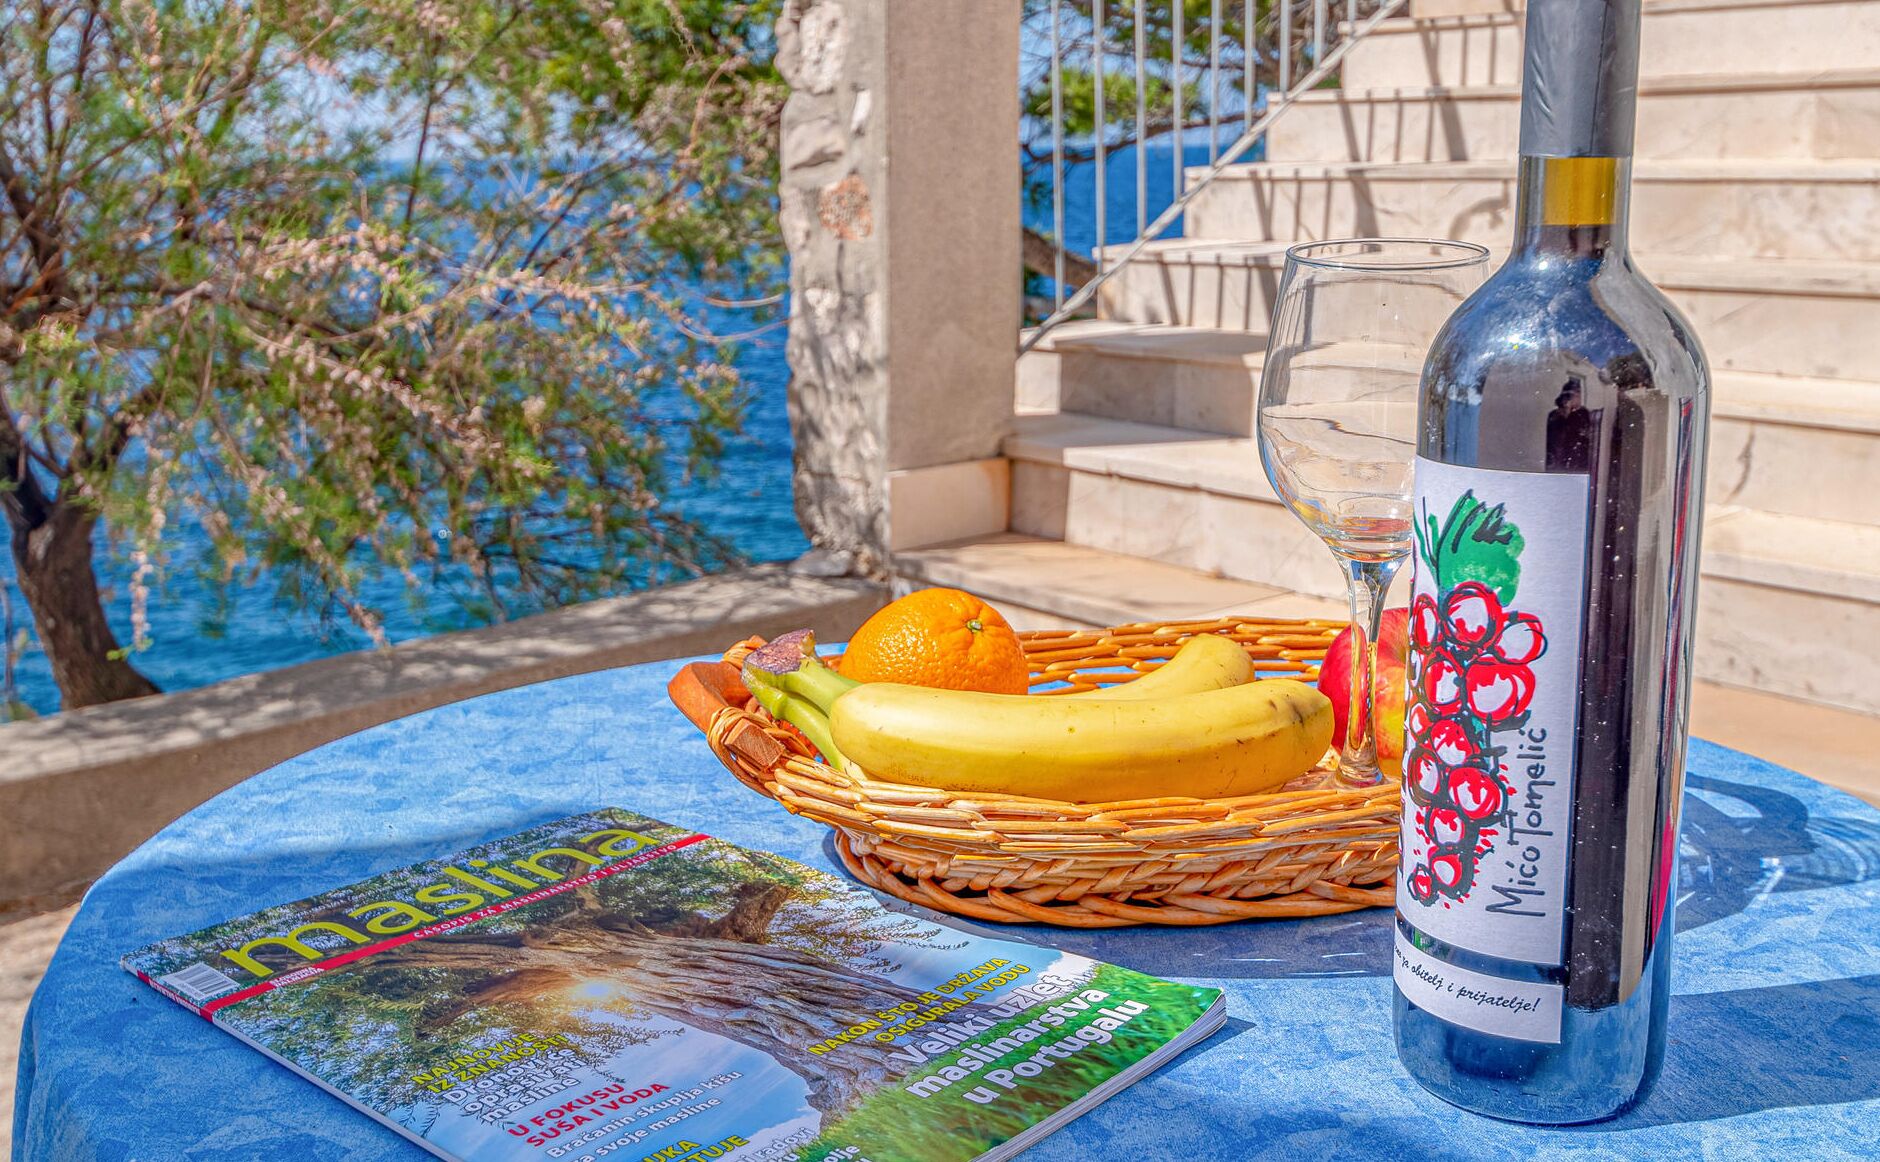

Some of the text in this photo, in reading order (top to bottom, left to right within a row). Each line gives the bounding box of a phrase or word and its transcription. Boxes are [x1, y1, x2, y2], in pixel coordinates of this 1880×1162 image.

[220, 829, 660, 977] maslina
[501, 873, 598, 910] MASLINARSTVO
[611, 843, 677, 872] ULJARSTVO
[808, 957, 1011, 1056] NAKON ŠTO JE DRŽAVA
[875, 963, 1031, 1043] OSIGURALA VODU
[1411, 964, 1444, 991] obitelj
[1447, 982, 1455, 992] i
[1456, 985, 1541, 1014] prijatelje!
[888, 974, 1076, 1067] Veliki uzlet
[904, 988, 1112, 1099] maslinarstva
[411, 1033, 537, 1085] NAJNOVIJE
[427, 1033, 570, 1093] IZ ZNANOSTI
[442, 1056, 547, 1102] Dronovi
[963, 999, 1150, 1105] u Portugalu
[464, 1056, 588, 1112] oprašivati
[480, 1076, 581, 1123] masline
[507, 1083, 625, 1137] U FOKUSU
[526, 1082, 670, 1147] SUŠA I VODA
[547, 1070, 744, 1159] Bračanin skuplja kišu
[595, 1128, 648, 1156] svoje
[649, 1097, 722, 1132] masline
[753, 1127, 816, 1158] radovi
